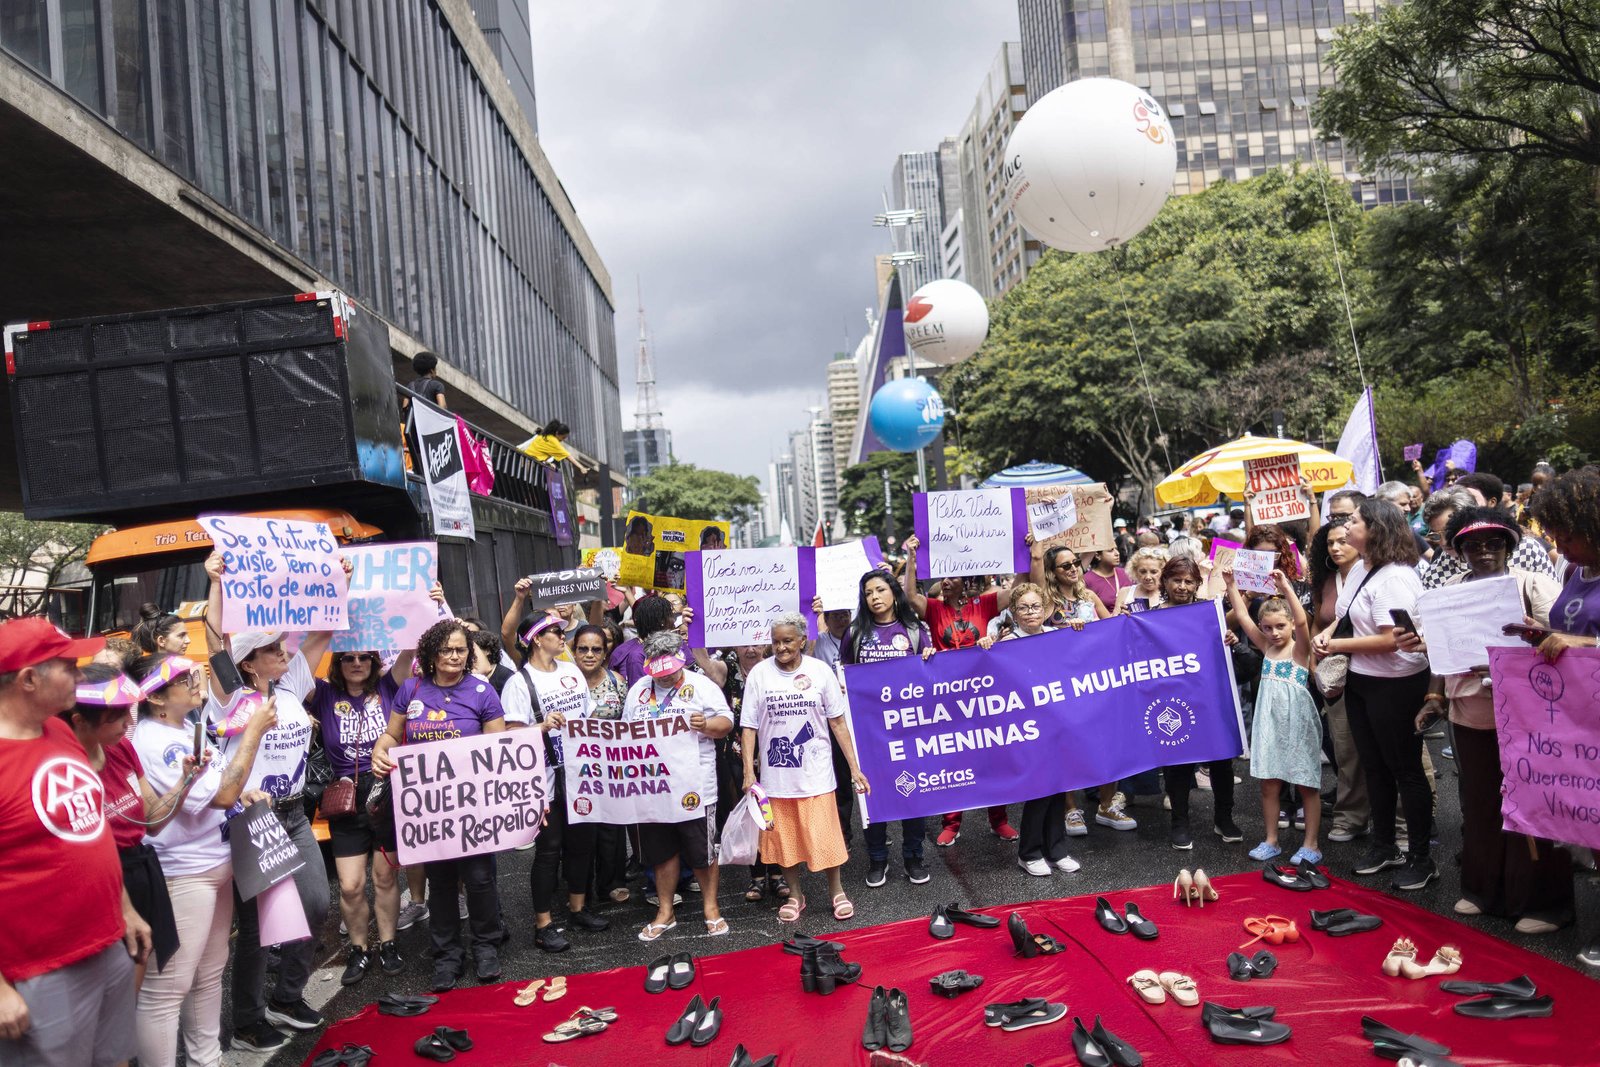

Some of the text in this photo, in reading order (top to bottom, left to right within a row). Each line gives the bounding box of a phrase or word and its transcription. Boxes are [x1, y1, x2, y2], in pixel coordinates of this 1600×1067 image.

[1248, 464, 1301, 492] NOSSA
[1305, 467, 1338, 482] SKOL
[929, 494, 1002, 519] Pela Vida
[1266, 489, 1297, 505] FEITA
[1287, 501, 1305, 516] QUE
[154, 533, 177, 547] Trio
[210, 518, 333, 554] Se o futuro
[931, 522, 1007, 543] das Mulheres
[958, 545, 973, 553] e
[223, 549, 277, 576] existe
[321, 563, 332, 577] o
[703, 555, 787, 579] Você vai se
[932, 556, 1003, 575] Meninas
[224, 574, 338, 600] rosto de uma
[538, 580, 600, 598] MULHERES VIVAS!
[705, 578, 796, 602] arrepender de
[246, 600, 319, 627] mulher
[705, 599, 784, 618] levantar a
[869, 650, 907, 658] MULHERES
[880, 674, 994, 703] 8 de março
[883, 653, 1201, 730] PELA VIDA DE MULHERES
[545, 703, 555, 712] DE
[554, 702, 582, 713] ENINAS
[766, 695, 784, 703] PELA
[767, 700, 817, 711] DE MULHERES
[774, 709, 808, 717] MENINAS
[1144, 698, 1161, 735] DEFENDER
[1170, 697, 1196, 725] ACOLHER
[409, 720, 455, 732] NENHUMA
[418, 729, 462, 740] MENOS
[568, 715, 690, 740] RESPEITA
[266, 733, 278, 741] DE
[888, 719, 1040, 761] E MENINAS
[1160, 734, 1190, 746] CUIDAR
[1528, 732, 1600, 761] Nós no
[576, 743, 660, 761] AS MINA
[397, 737, 537, 789] ELA NÃO
[578, 762, 671, 780] AS MONA
[917, 768, 975, 788] Sefras
[1517, 757, 1600, 791] Queremos
[577, 779, 672, 798] AS MANA
[948, 780, 976, 789] FRANCISCANA
[400, 782, 477, 818] QUER
[1543, 791, 1600, 825] Vivas
[401, 818, 456, 849] QUER
